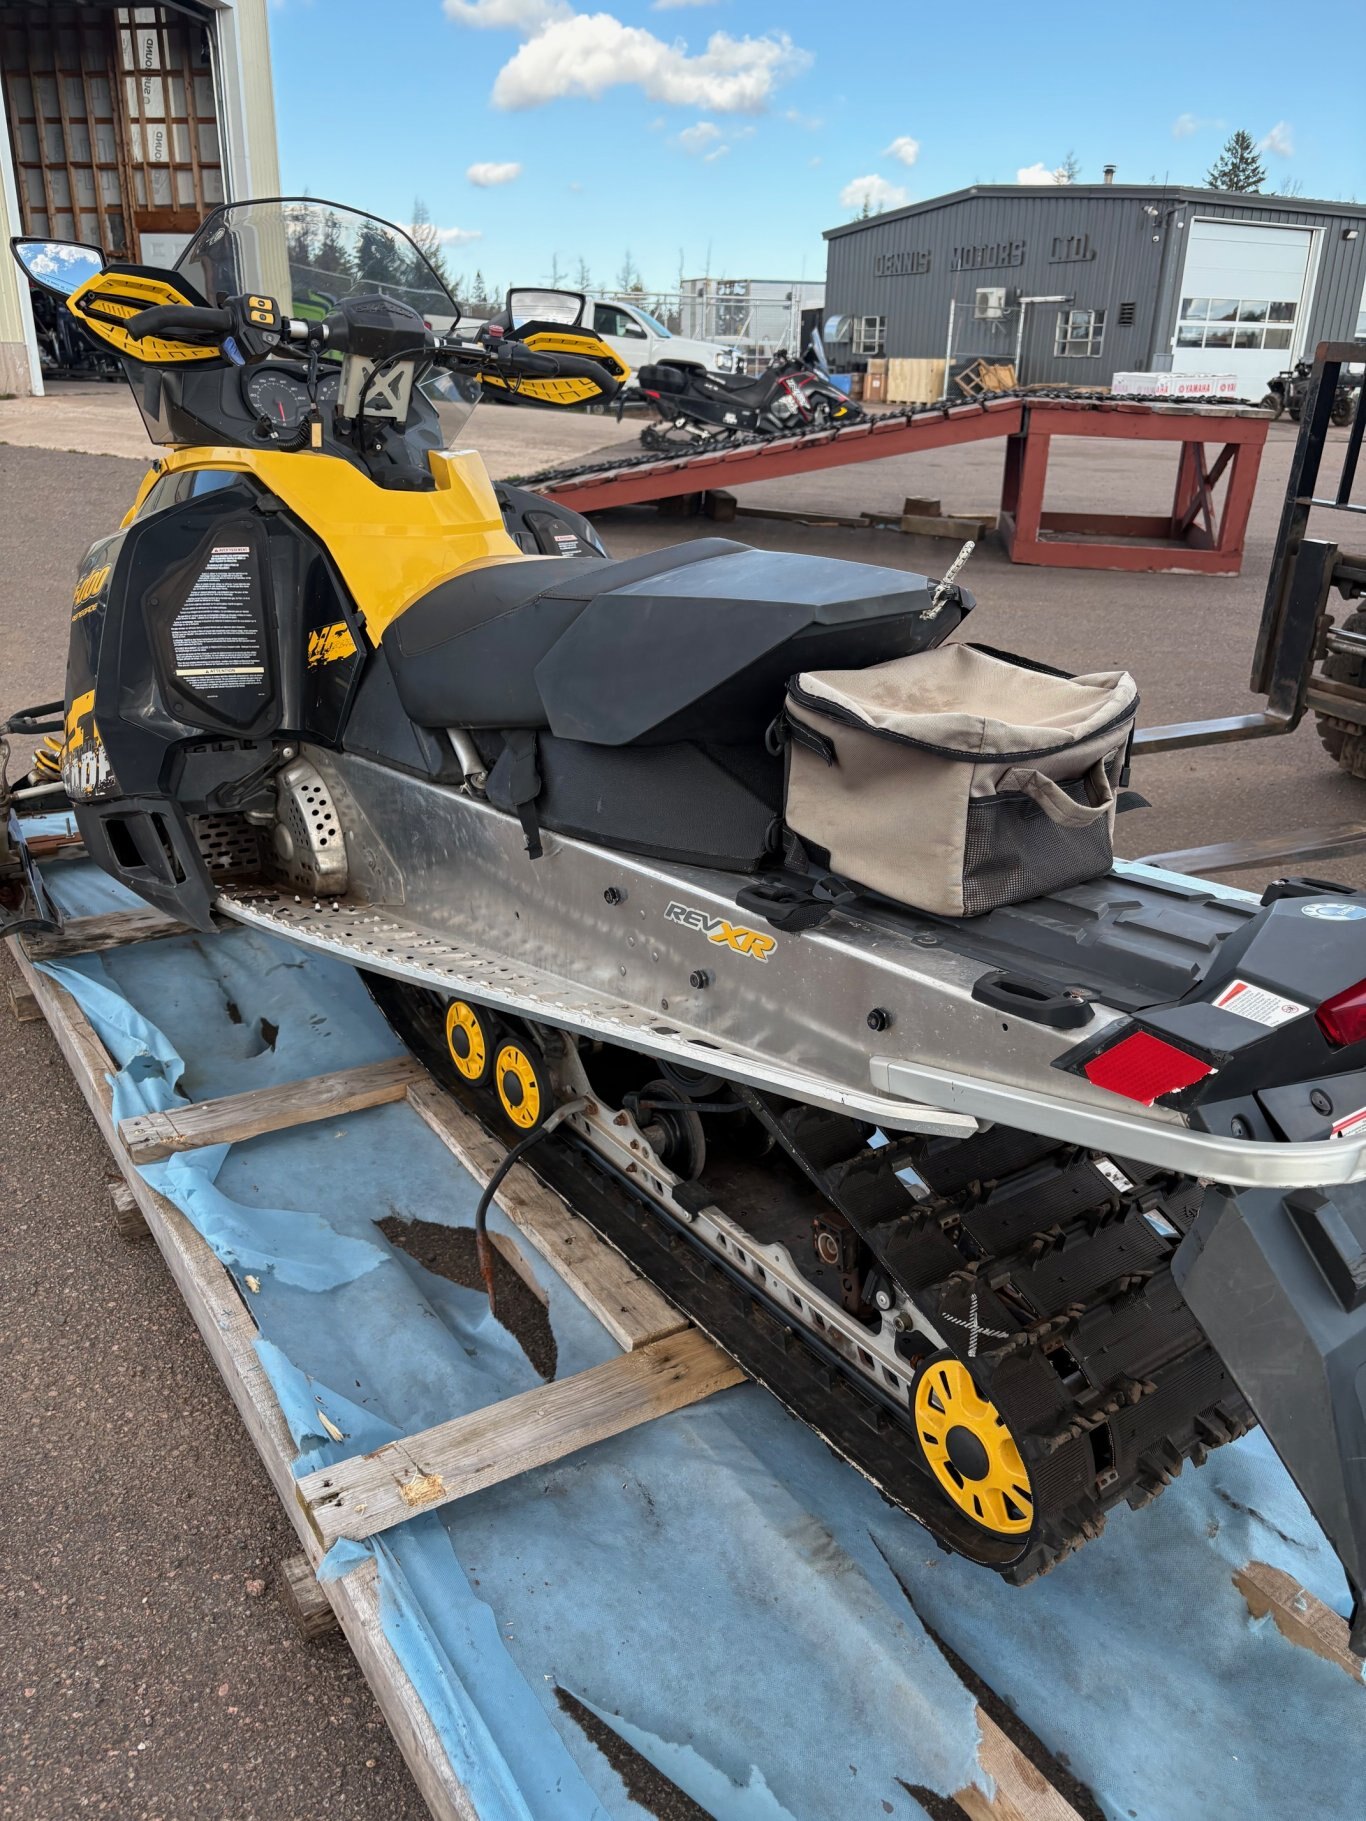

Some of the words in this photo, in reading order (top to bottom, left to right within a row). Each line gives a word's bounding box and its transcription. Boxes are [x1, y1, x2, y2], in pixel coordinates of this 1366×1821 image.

[875, 250, 930, 277] DENNIS
[950, 240, 1025, 271] MOTORS
[1186, 383, 1211, 393] YAMAHA
